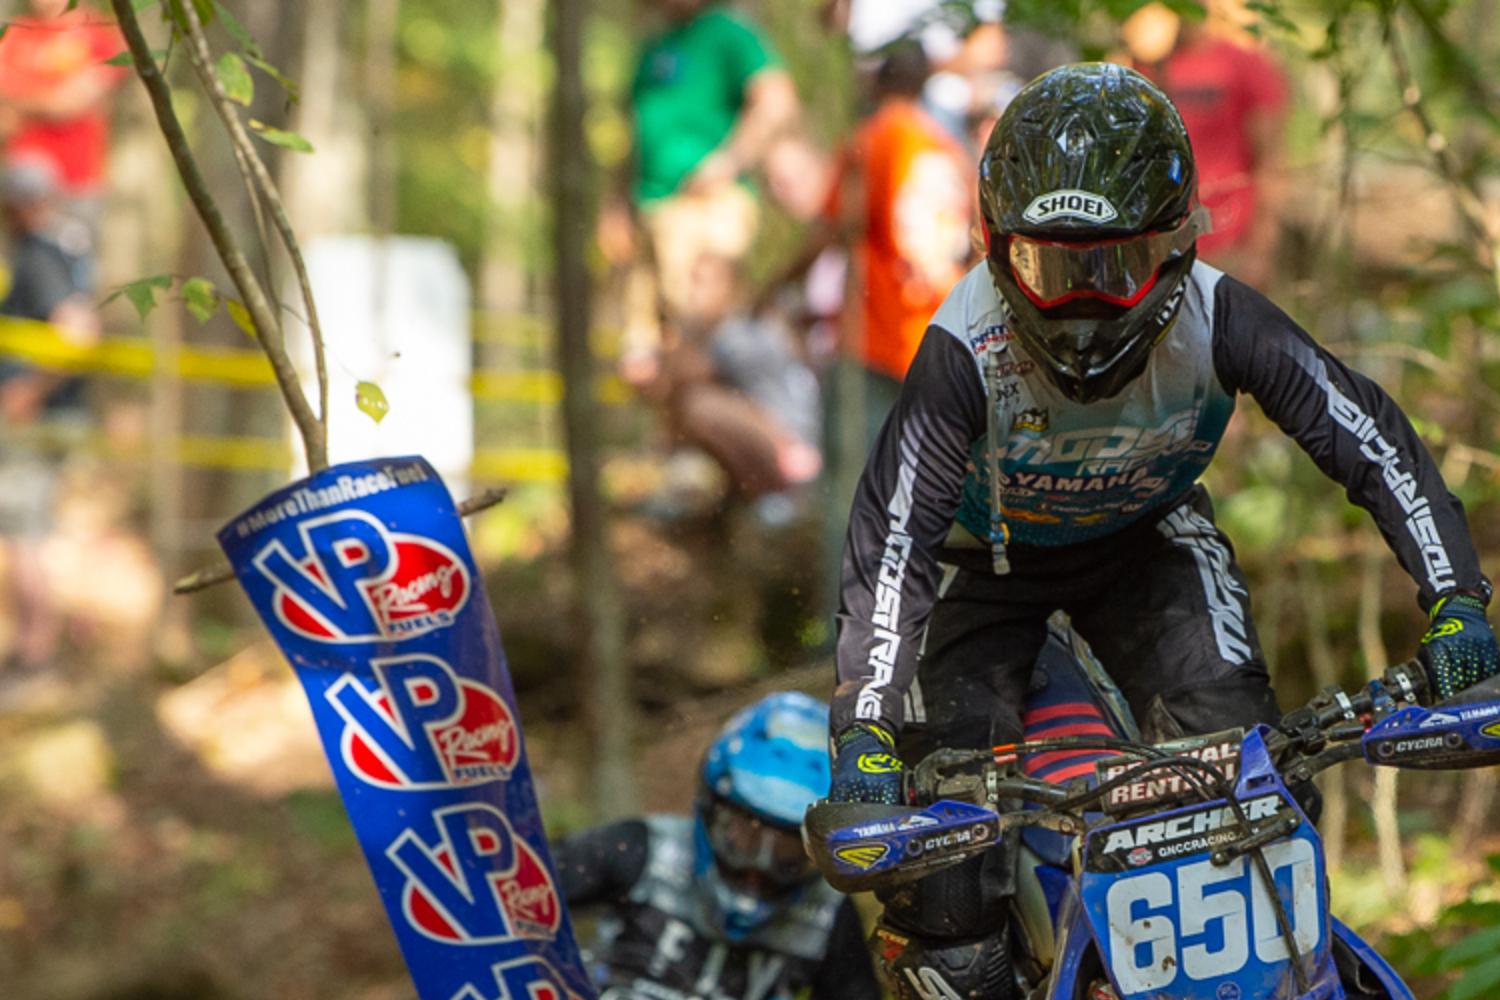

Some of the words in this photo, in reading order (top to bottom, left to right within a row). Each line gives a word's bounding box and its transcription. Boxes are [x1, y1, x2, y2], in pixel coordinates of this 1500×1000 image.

[1037, 195, 1103, 217] SHOEI
[1014, 469, 1148, 493] YAMAHA
[252, 509, 399, 642] VP
[373, 564, 459, 613] Racing
[324, 654, 467, 789] VP
[440, 719, 513, 762] Racing
[1395, 737, 1444, 752] CYCRA
[1103, 794, 1281, 855] ARCHER
[385, 803, 519, 945] VP
[1106, 837, 1321, 995] 650
